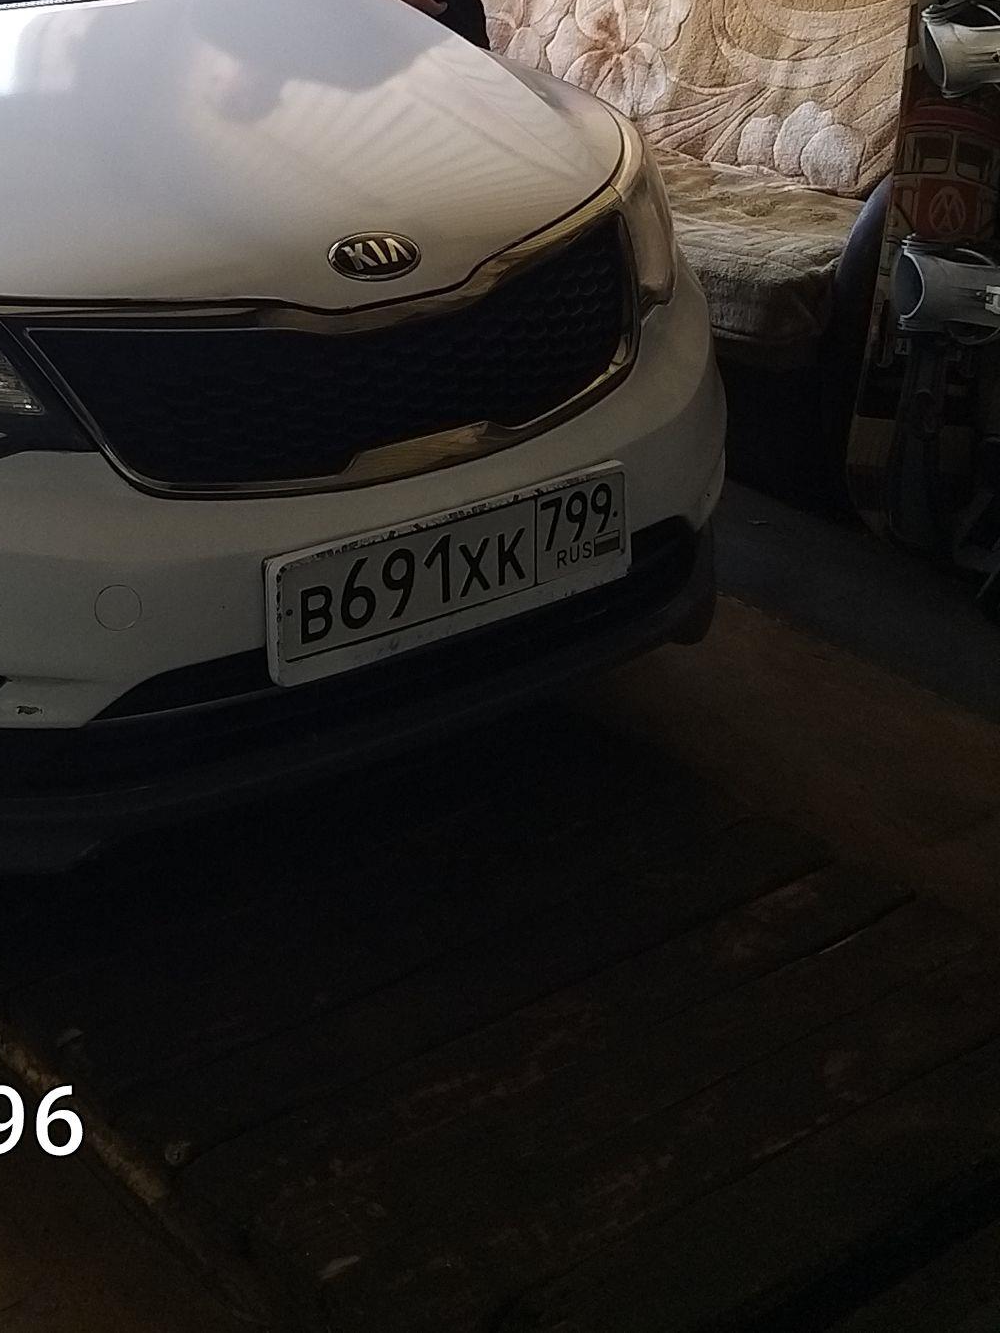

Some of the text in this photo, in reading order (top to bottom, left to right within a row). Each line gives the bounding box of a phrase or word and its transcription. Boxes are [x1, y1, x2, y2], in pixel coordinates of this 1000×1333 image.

[340, 237, 413, 271] KIA
[540, 482, 612, 552] 799
[556, 544, 592, 568] RUS
